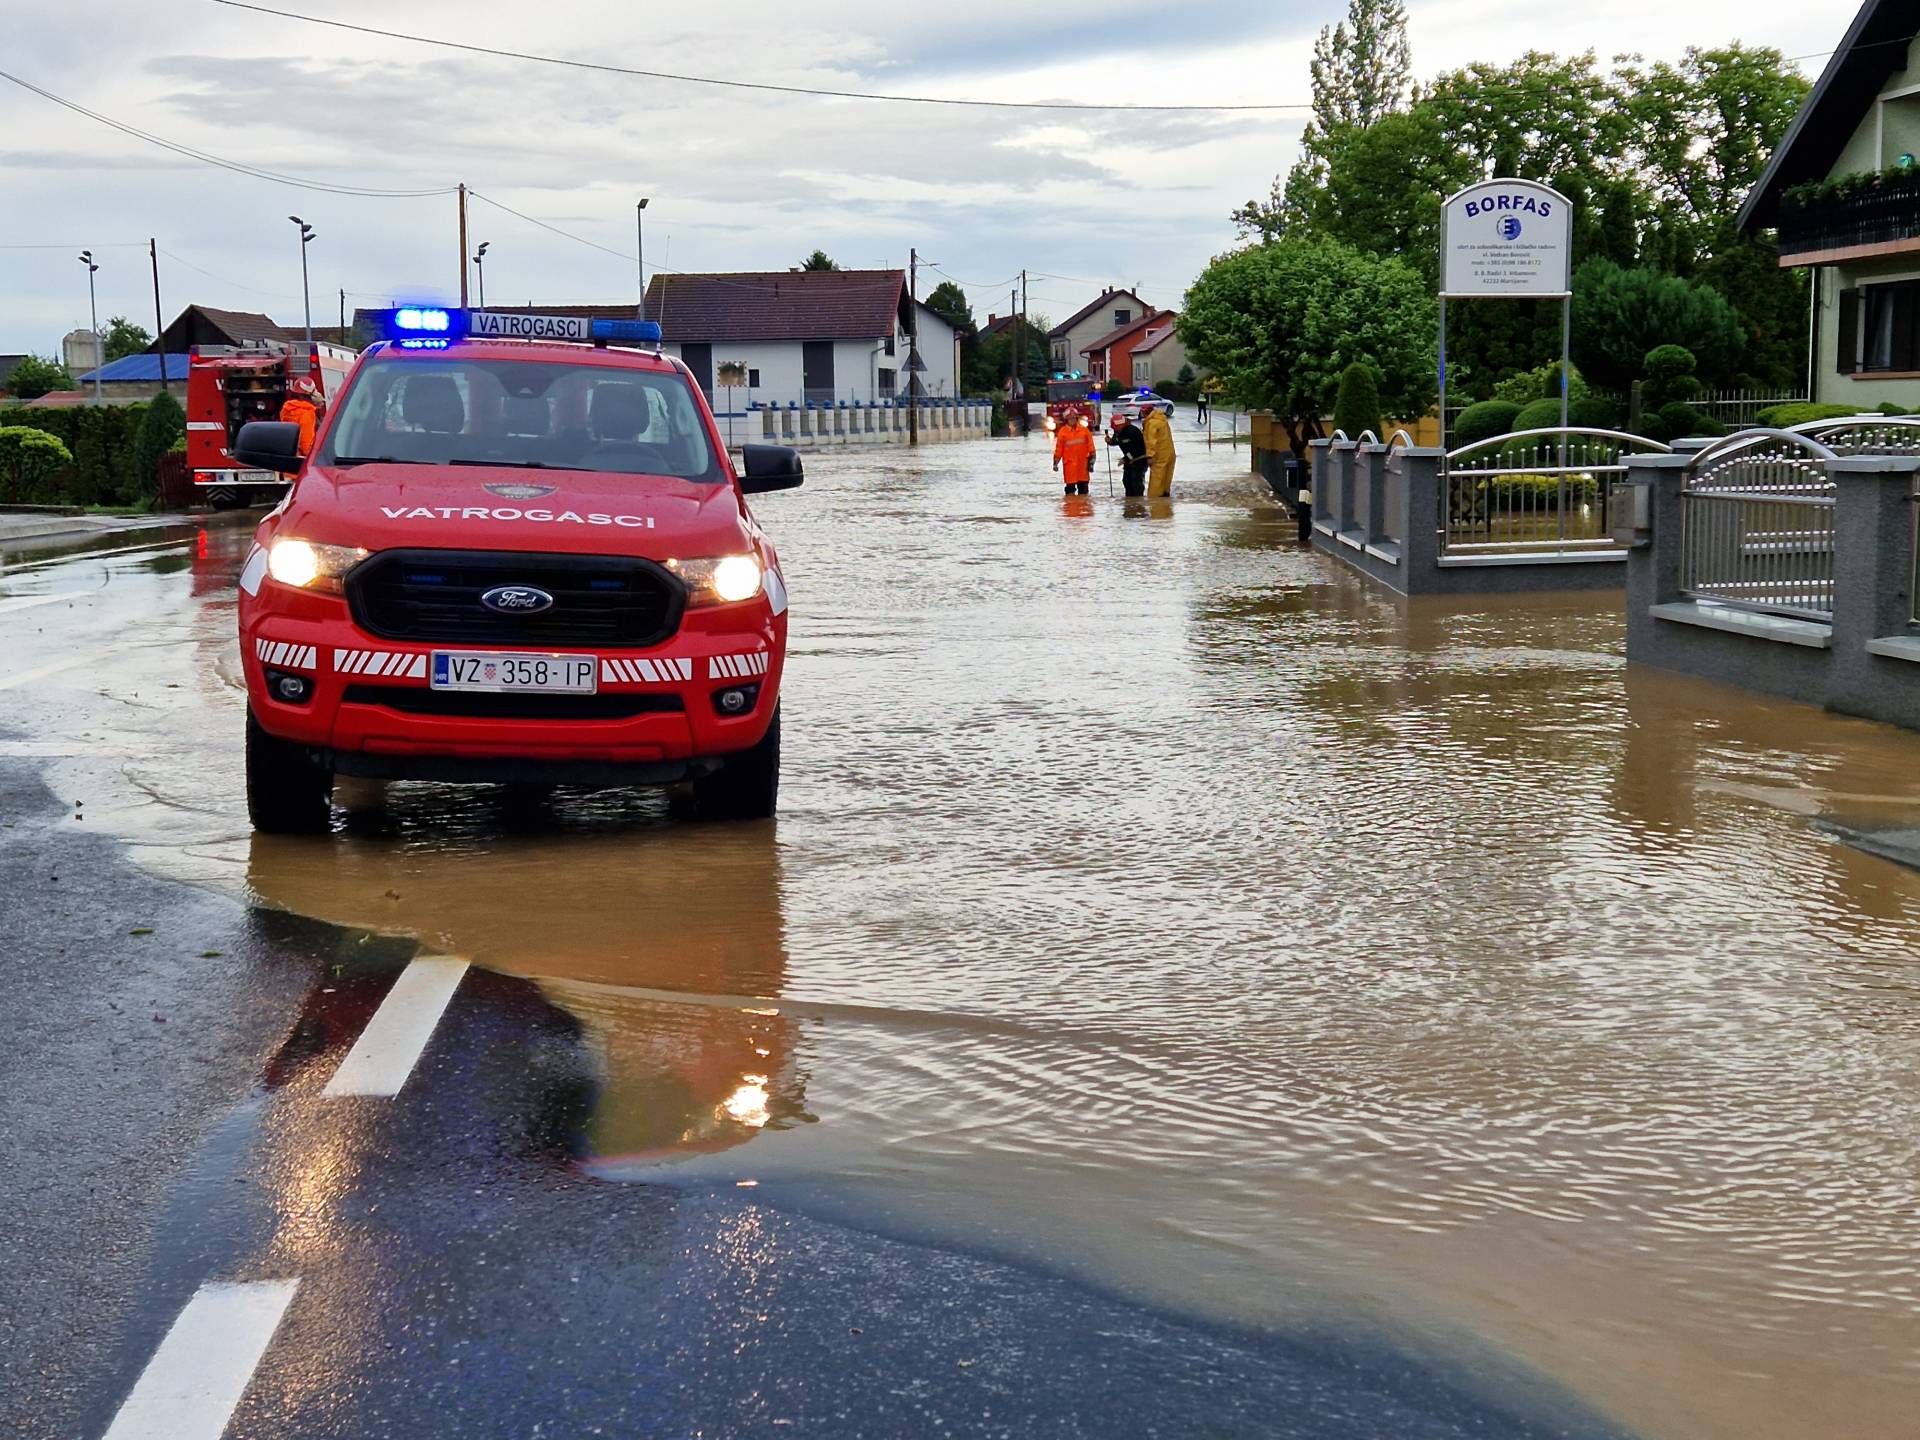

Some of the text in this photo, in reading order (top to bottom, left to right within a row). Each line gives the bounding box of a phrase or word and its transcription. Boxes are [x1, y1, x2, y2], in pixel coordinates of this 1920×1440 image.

[1465, 195, 1552, 217] BORFAS
[479, 315, 581, 337] VATROGASCI
[380, 507, 655, 529] VATROGASCI
[498, 591, 537, 608] Ford
[435, 673, 447, 681] HR
